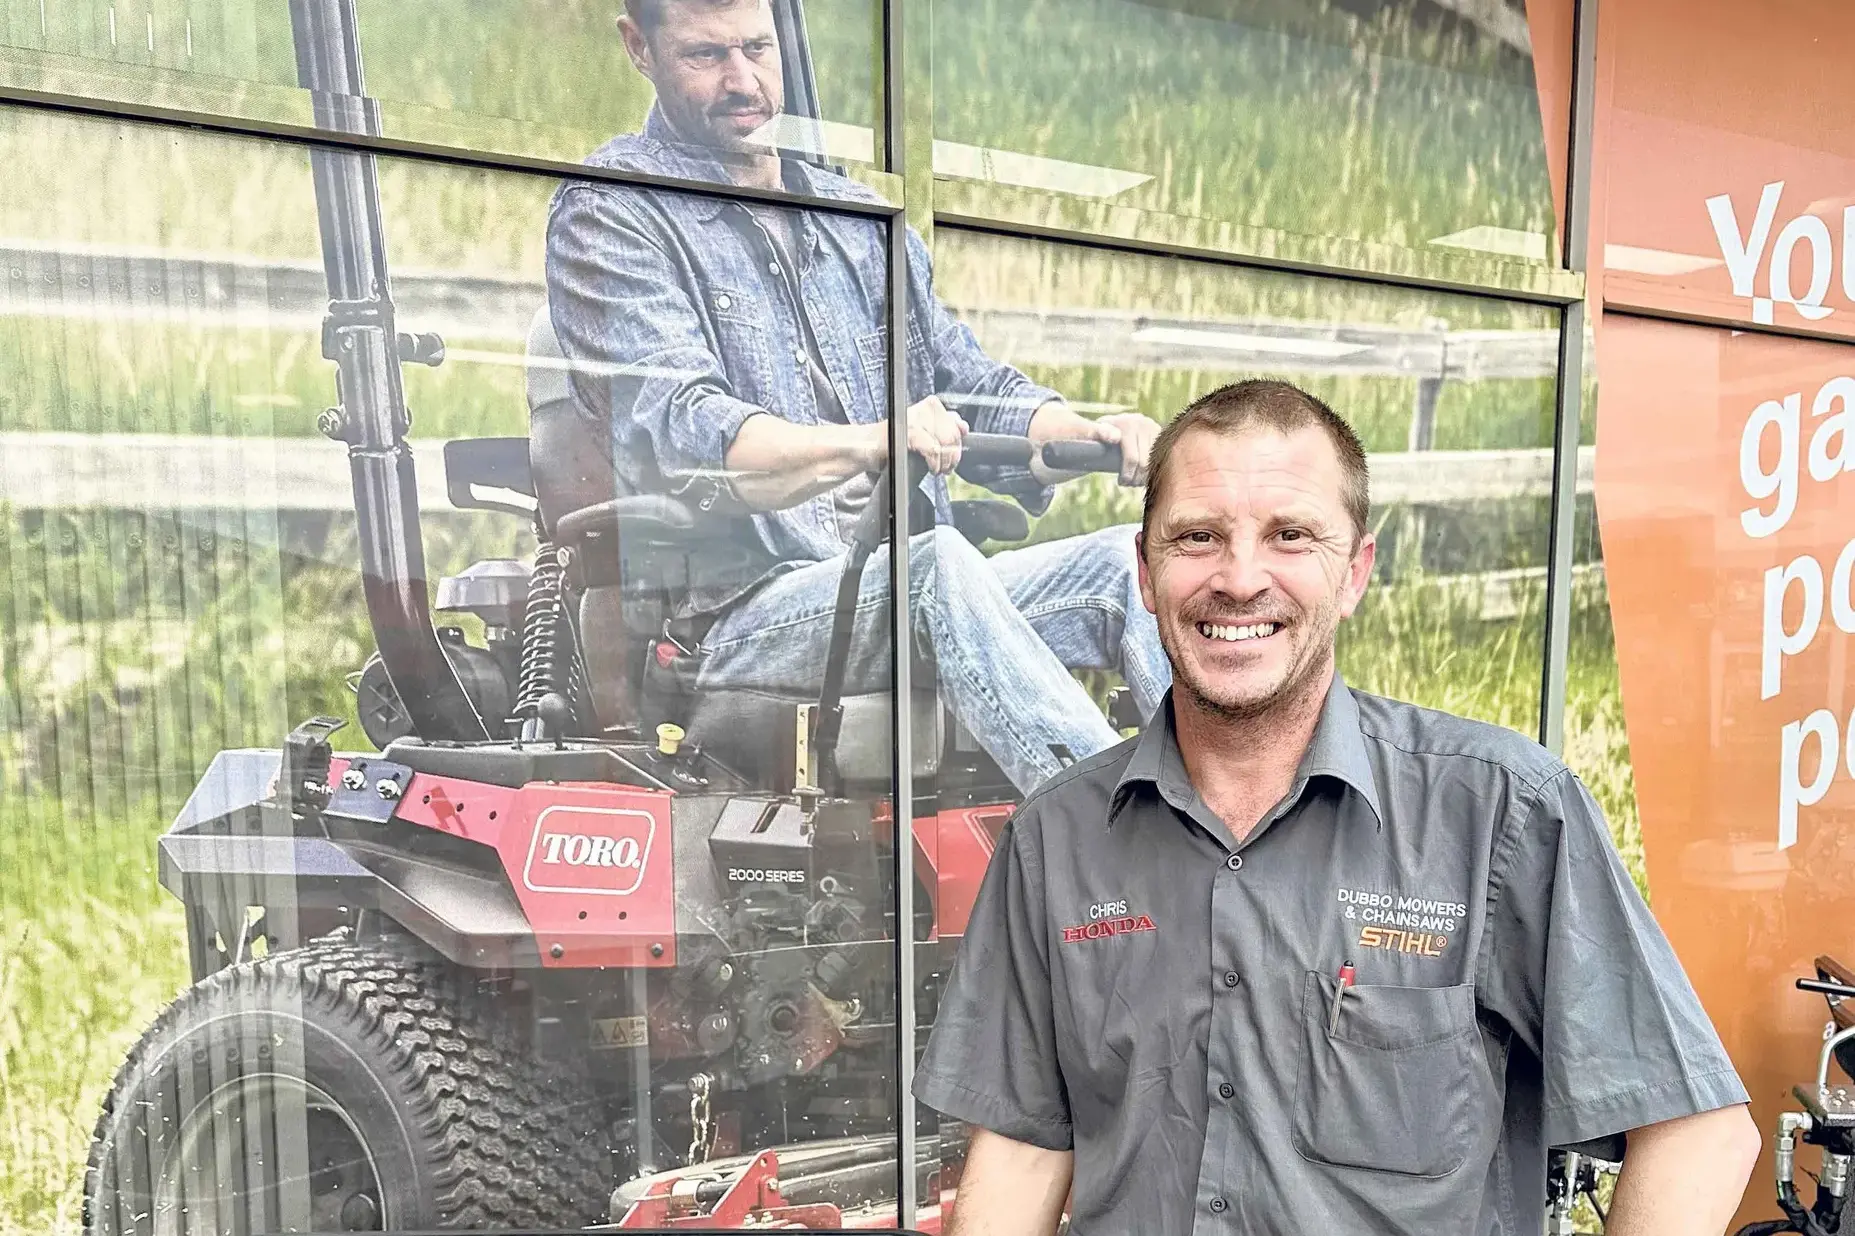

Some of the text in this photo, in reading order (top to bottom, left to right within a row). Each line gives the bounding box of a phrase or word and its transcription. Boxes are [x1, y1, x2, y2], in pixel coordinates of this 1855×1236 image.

[1704, 180, 1855, 326] Yo
[1778, 697, 1855, 851] p
[728, 868, 805, 883] 2000 SERIES
[1089, 899, 1128, 919] CHRIS
[1337, 888, 1467, 917] DUBBO MOWERS
[1062, 914, 1157, 943] HONDA
[1344, 905, 1456, 932] & CHAINSAWS
